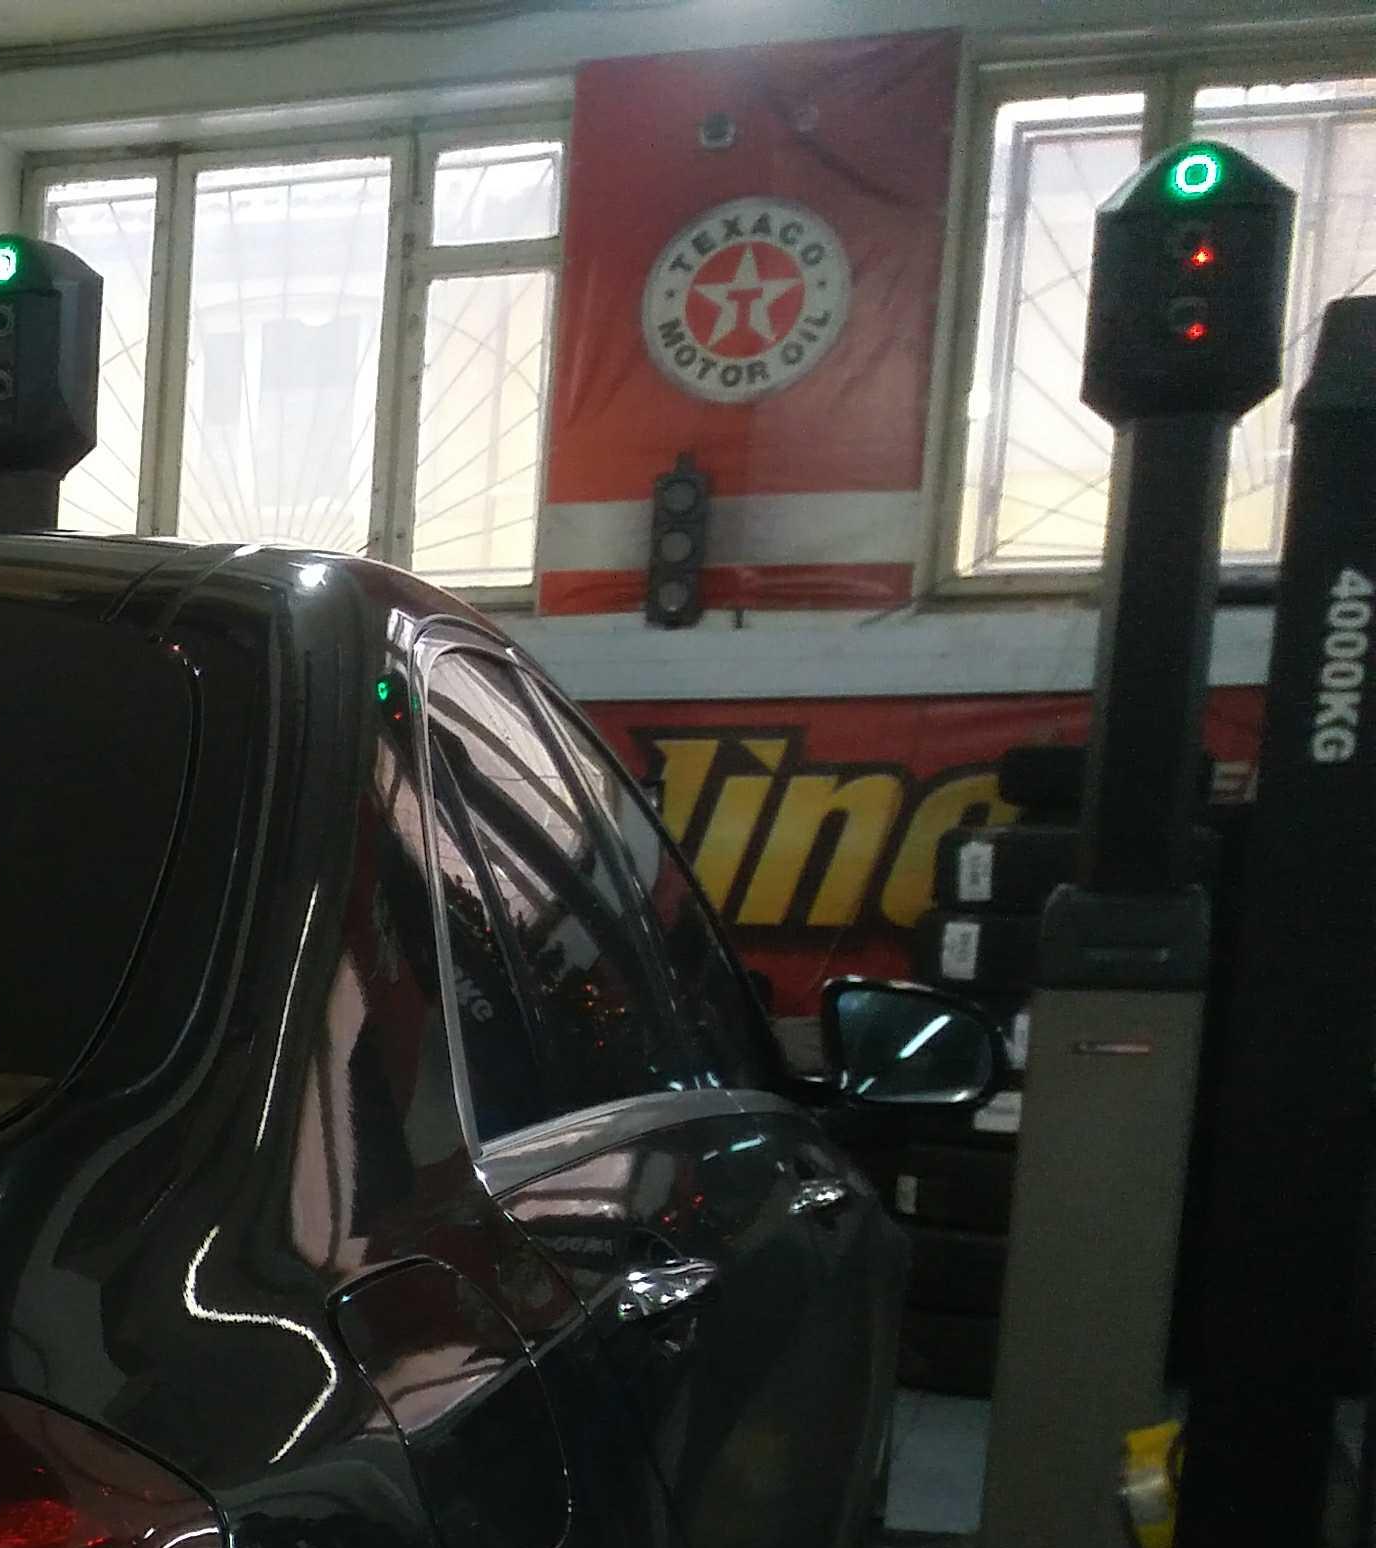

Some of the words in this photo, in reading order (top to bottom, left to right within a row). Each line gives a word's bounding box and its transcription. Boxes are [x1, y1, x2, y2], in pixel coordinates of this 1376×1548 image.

[669, 212, 825, 273] TEXACO
[658, 318, 770, 388] MOTOR
[781, 310, 832, 366] OIL
[1311, 567, 1376, 764] 4000KG
